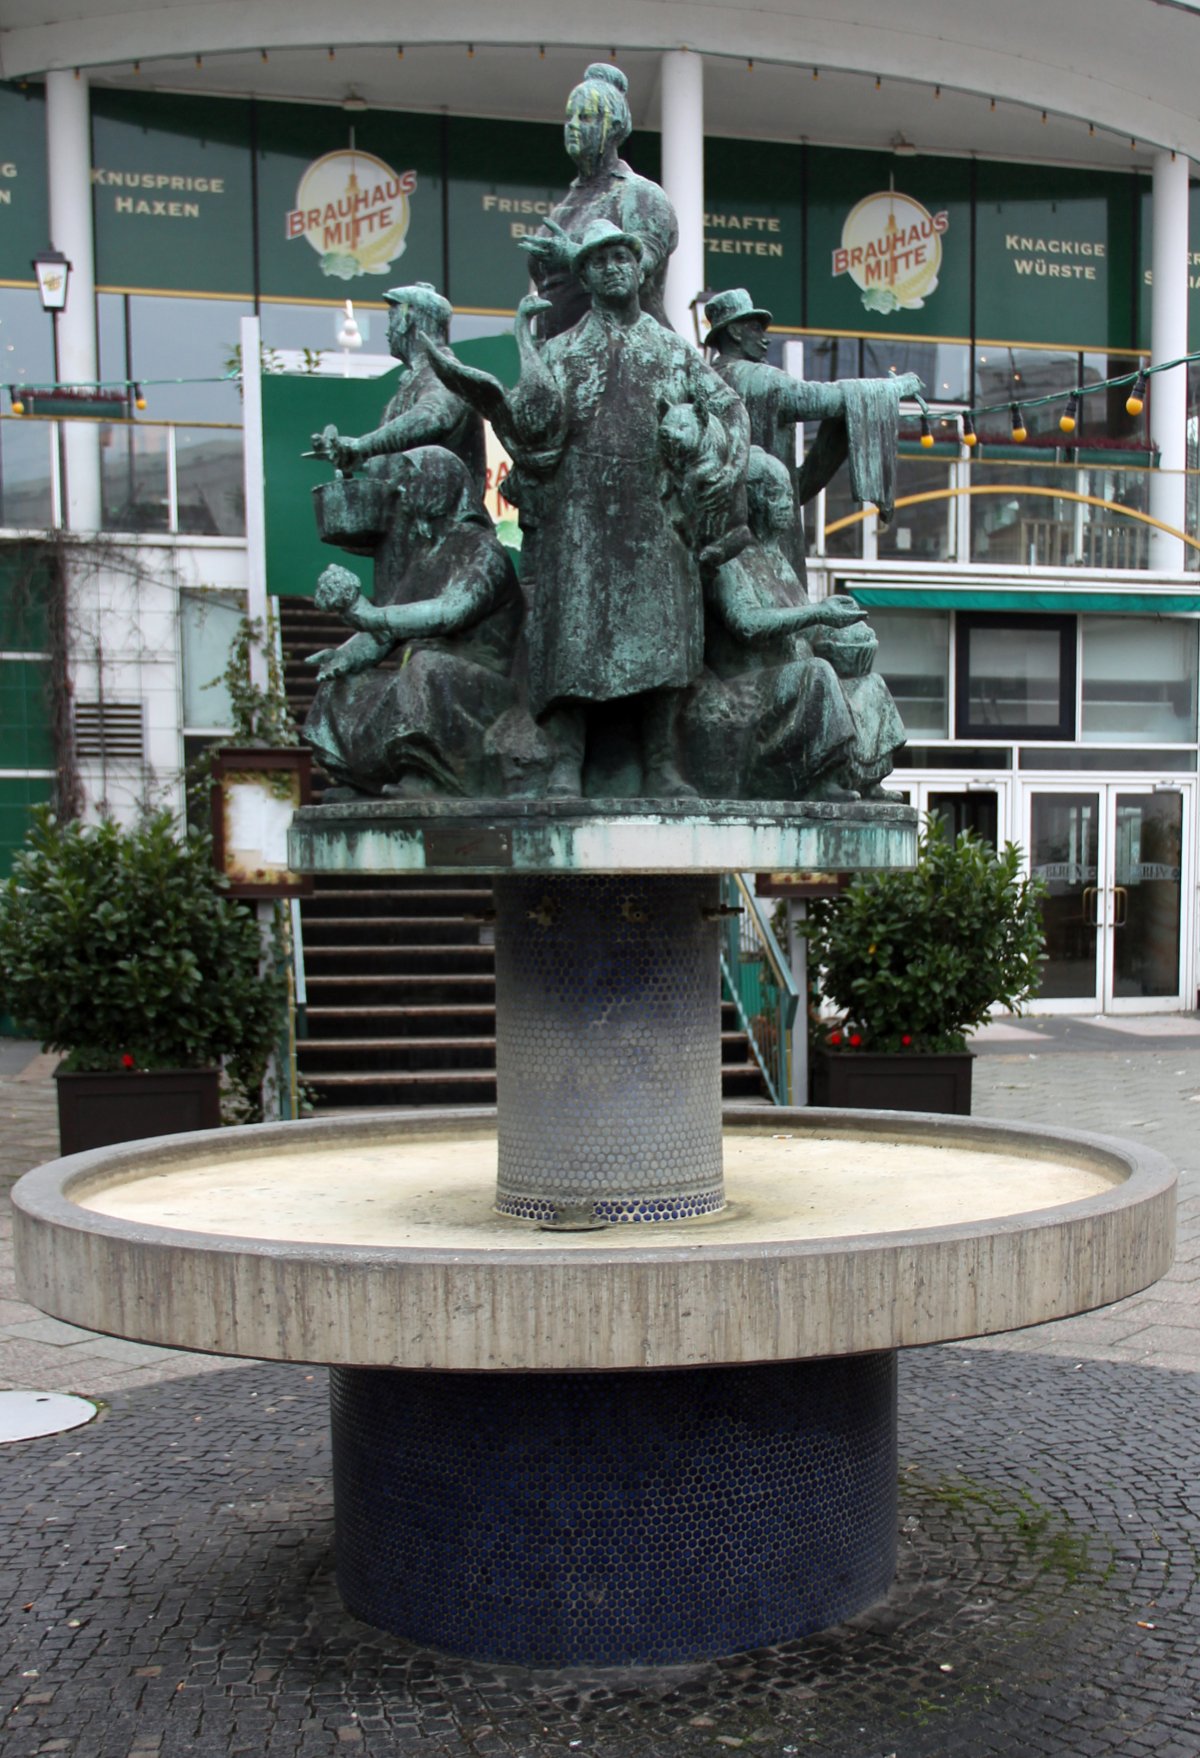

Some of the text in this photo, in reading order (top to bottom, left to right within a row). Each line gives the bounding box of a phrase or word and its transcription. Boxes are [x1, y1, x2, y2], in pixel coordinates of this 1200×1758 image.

[91, 169, 225, 193] KNUSPRIGE
[115, 196, 199, 218] HAXEN
[288, 171, 417, 239] BRAUHAUS
[324, 206, 393, 250] MITTE
[703, 213, 781, 232] ZHAFTE
[703, 238, 783, 257] ZEITEN
[834, 212, 948, 275] BRAUHAUS
[1005, 234, 1105, 257] KNACKIGE
[865, 244, 927, 286] MITTE
[1014, 258, 1097, 280] WÜRSTE
[1046, 865, 1084, 878] BERLN
